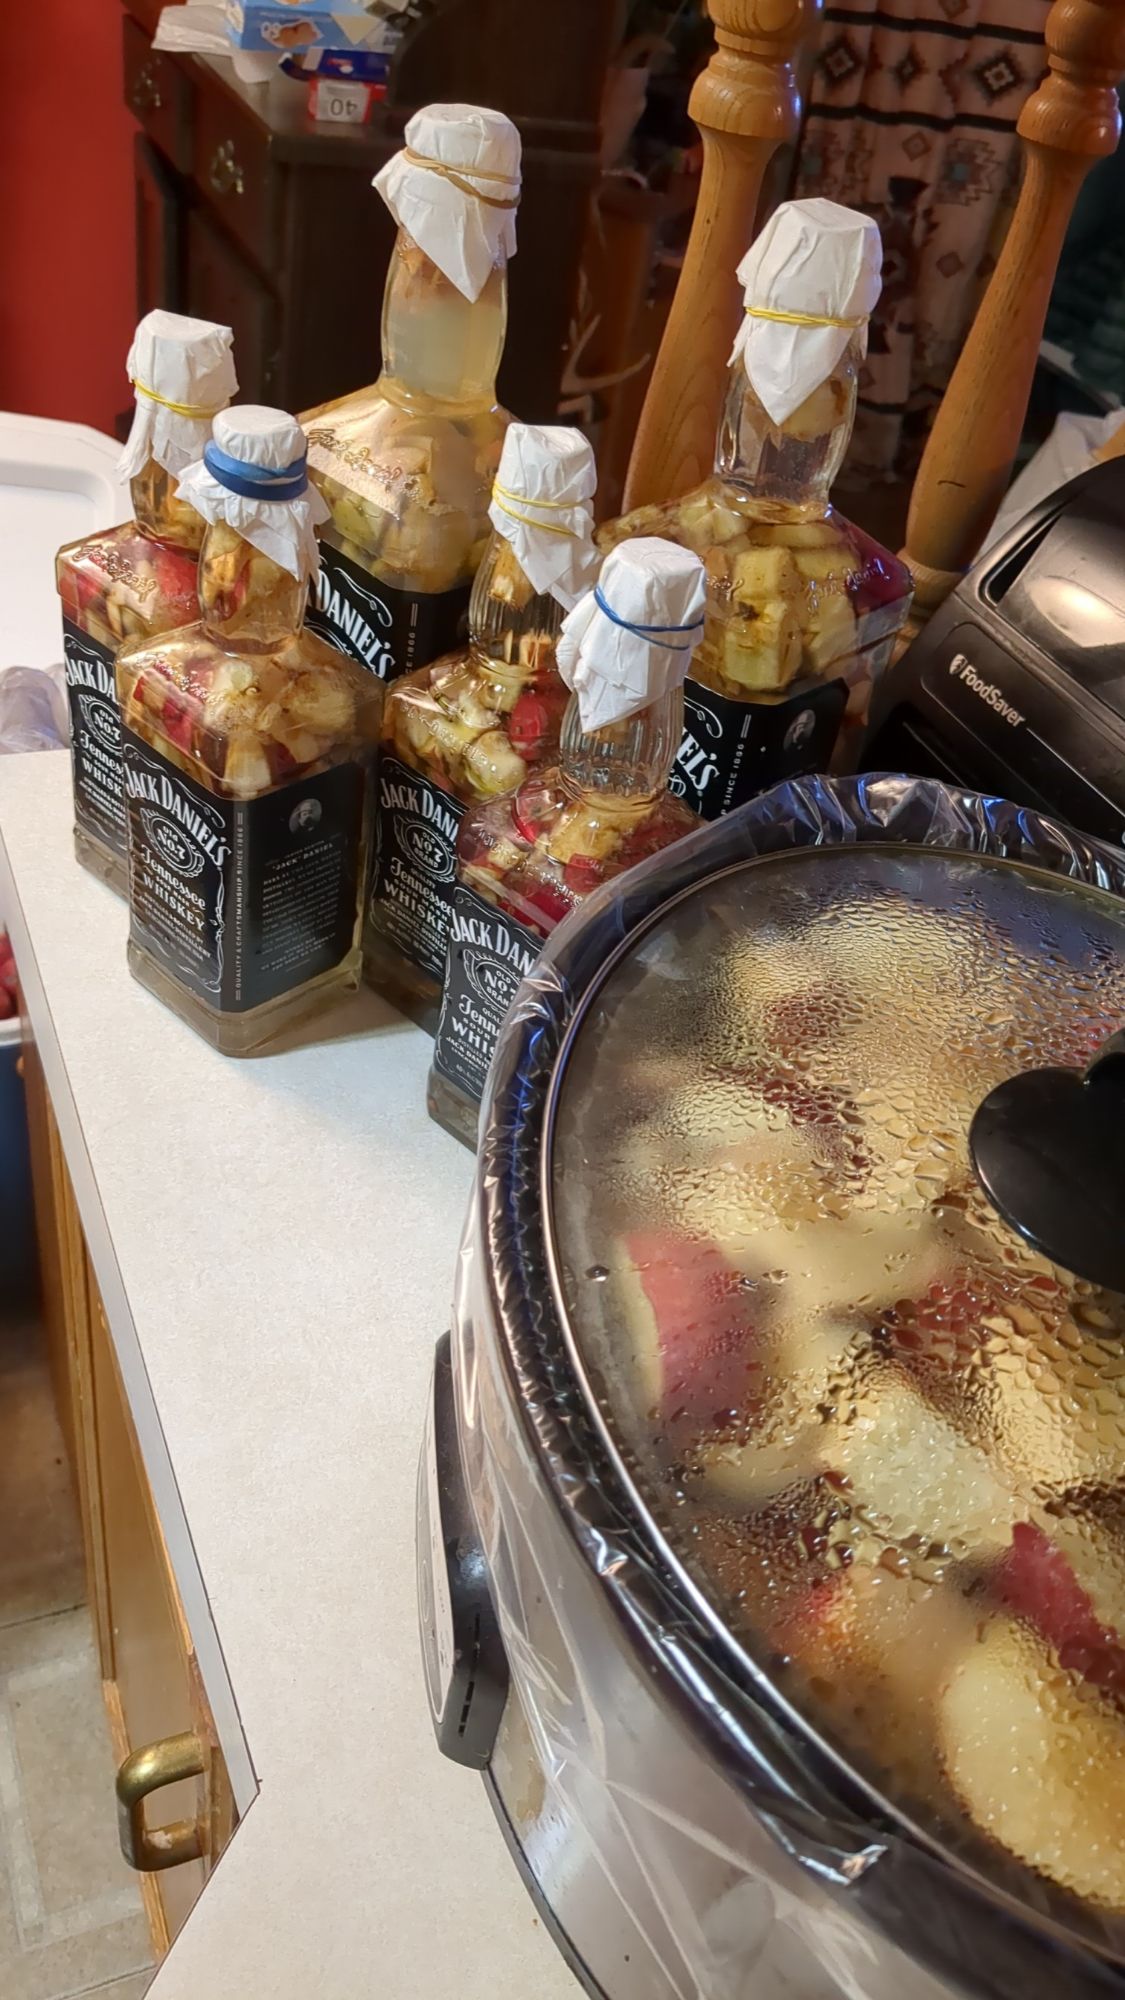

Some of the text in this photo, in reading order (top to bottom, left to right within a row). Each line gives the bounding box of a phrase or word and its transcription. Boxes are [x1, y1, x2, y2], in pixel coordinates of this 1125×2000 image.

[64, 651, 98, 691] JACK
[97, 660, 121, 706] DA
[960, 665, 1026, 727] FoodSaver
[82, 757, 123, 798] WHISK
[676, 727, 720, 790] EL'S
[123, 763, 160, 806] JACK
[160, 774, 232, 866] DANIEL'S
[380, 778, 420, 813] JACK
[421, 788, 460, 846] DANI
[141, 843, 206, 911] Tennessee
[143, 872, 205, 932] WHISKEY
[450, 908, 494, 950] JACK
[495, 923, 536, 977] DAN
[459, 994, 501, 1036] Tenn
[482, 1007, 502, 1025] QUAL
[486, 986, 510, 1008] BRAN
[451, 1016, 496, 1055] WHIS
[463, 1017, 490, 1040] SOUR
[466, 1049, 489, 1072] DANIE
